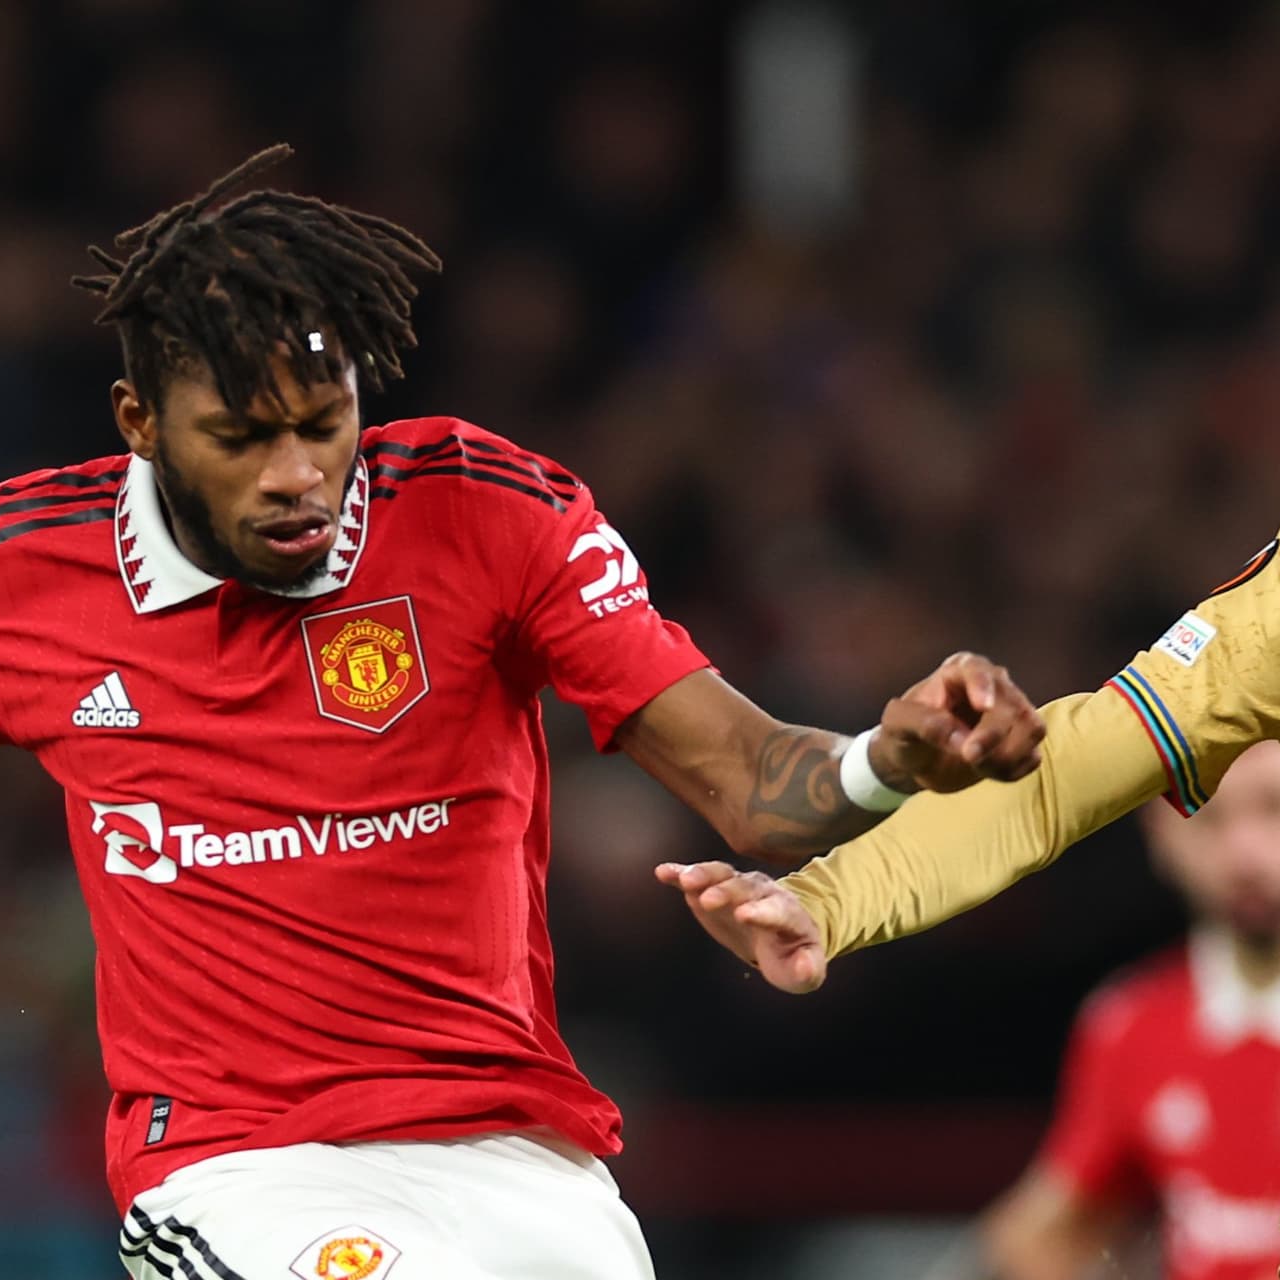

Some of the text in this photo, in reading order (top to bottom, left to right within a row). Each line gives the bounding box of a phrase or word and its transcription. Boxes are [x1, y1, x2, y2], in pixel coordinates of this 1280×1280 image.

[328, 625, 400, 662] MANCHESTER
[348, 684, 399, 705] UNITED
[72, 706, 141, 728] adidas
[169, 797, 457, 868] TeamViewer
